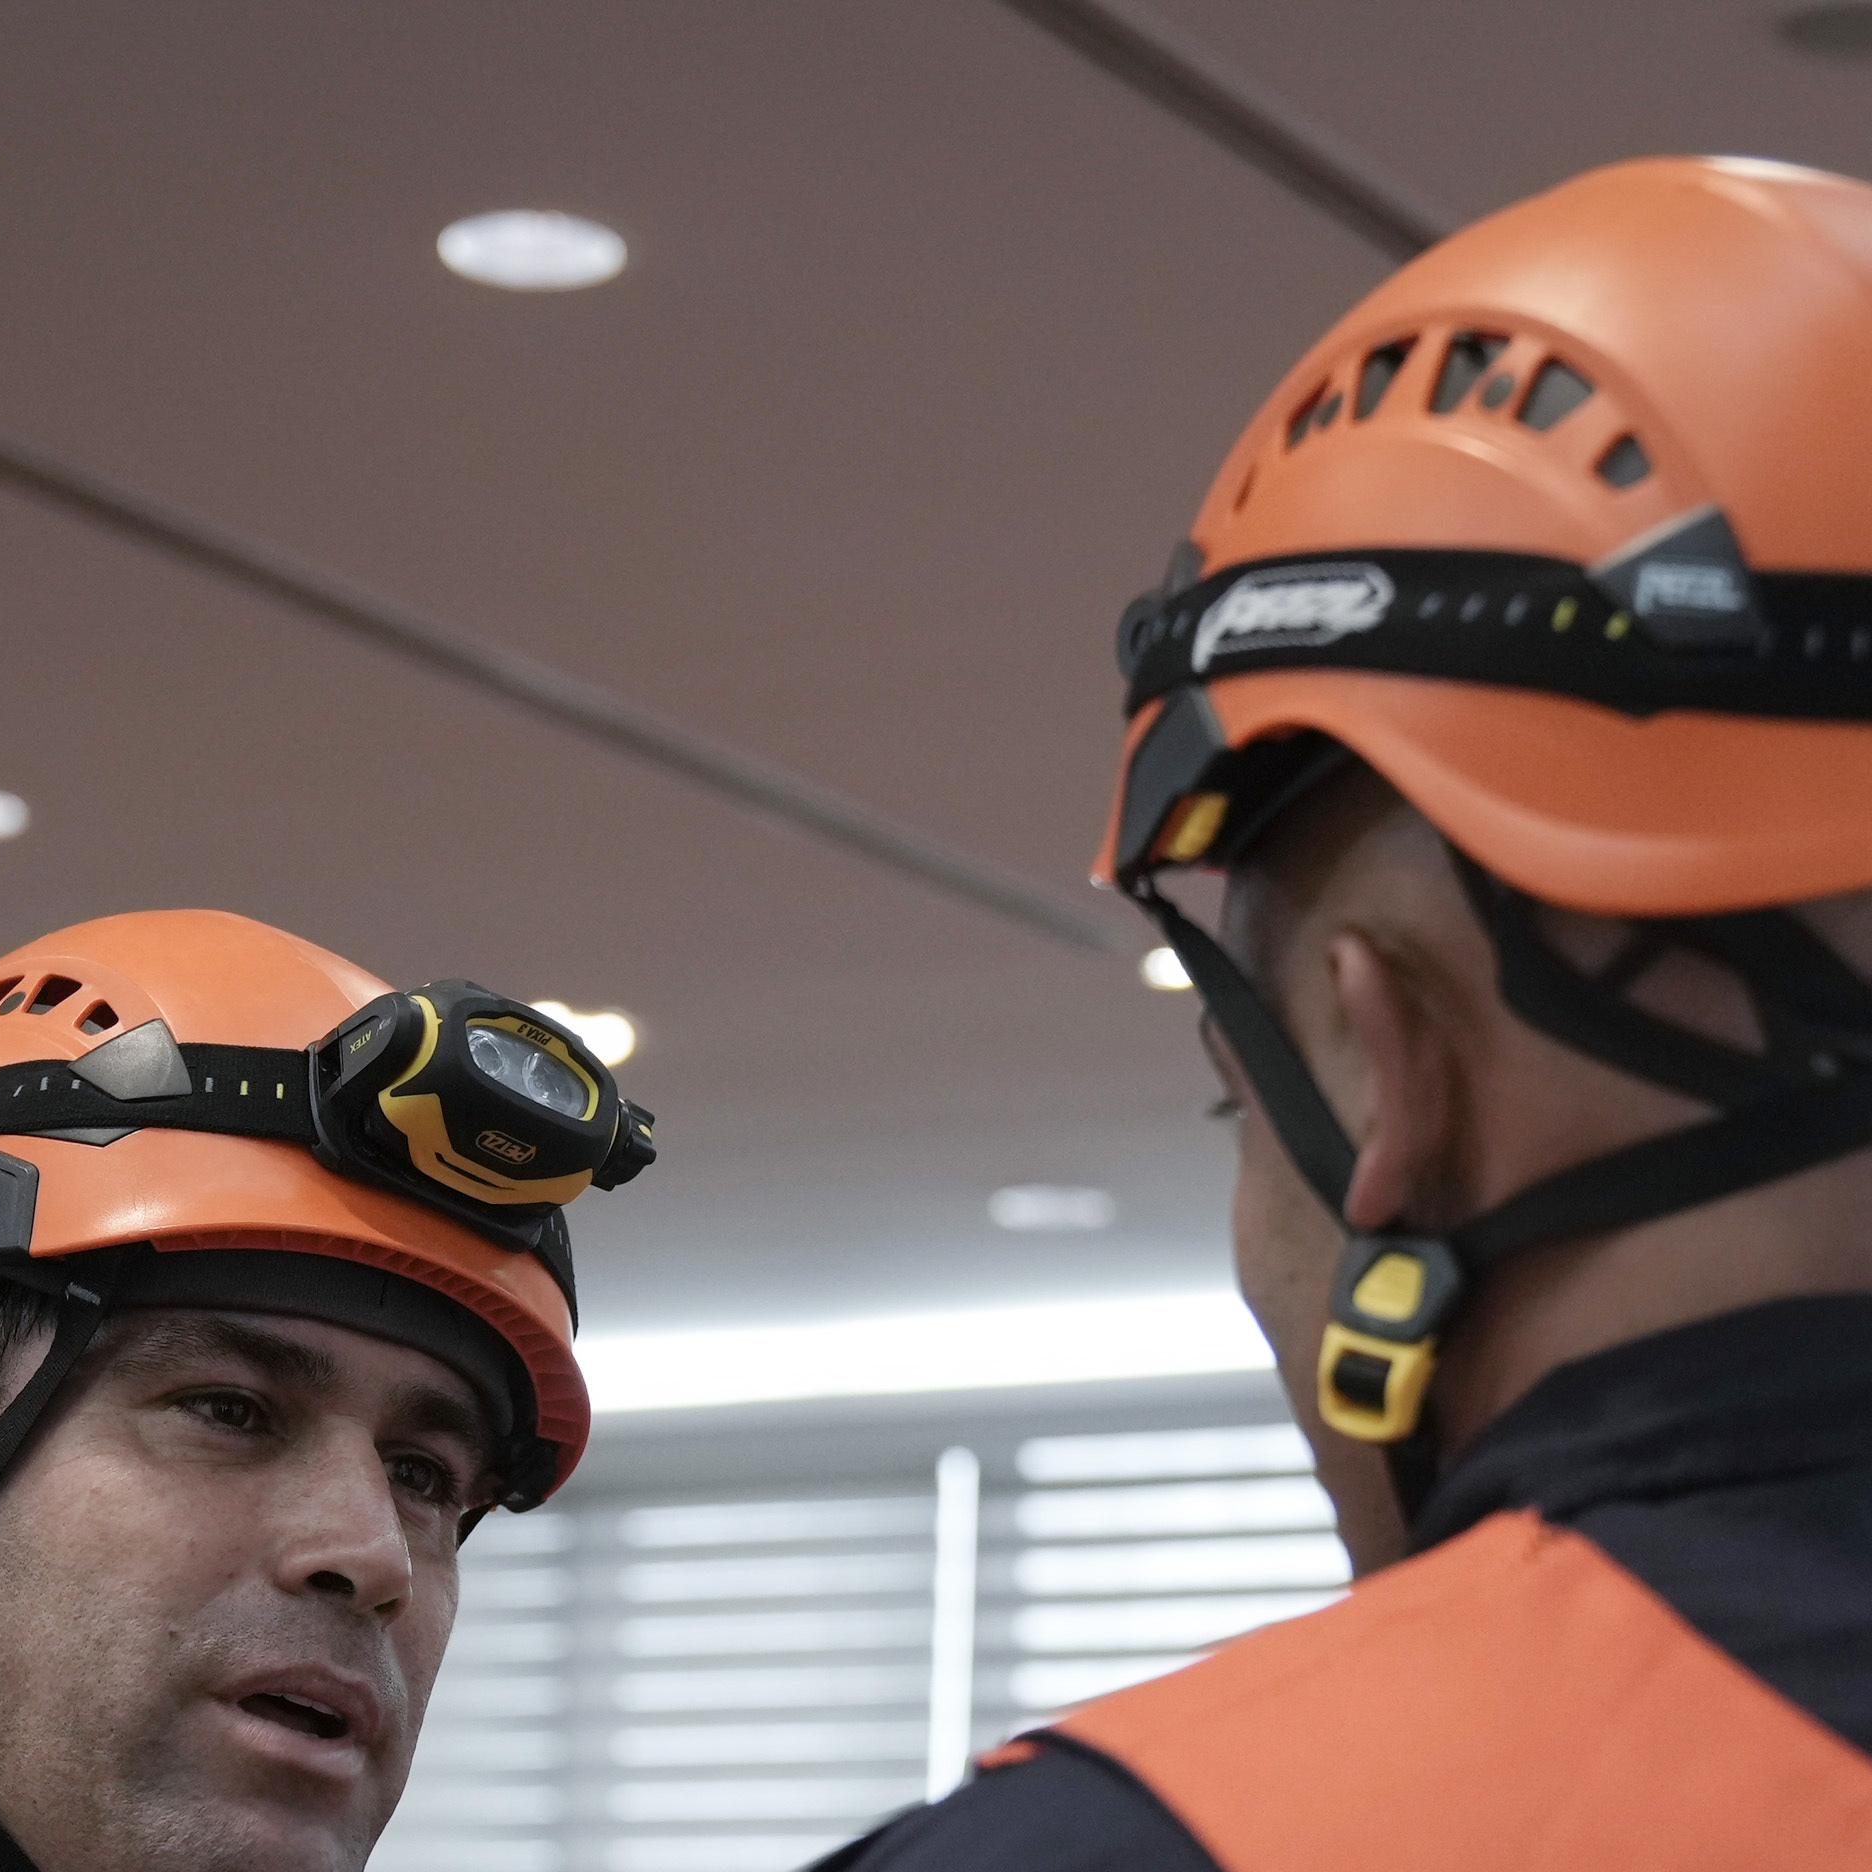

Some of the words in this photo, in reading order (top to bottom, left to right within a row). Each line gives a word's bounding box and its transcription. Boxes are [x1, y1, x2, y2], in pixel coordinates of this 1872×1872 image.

[517, 1023, 528, 1033] 3
[526, 1027, 552, 1046] PIXA
[349, 1030, 372, 1054] ATEX
[481, 1131, 536, 1162] PETZL
